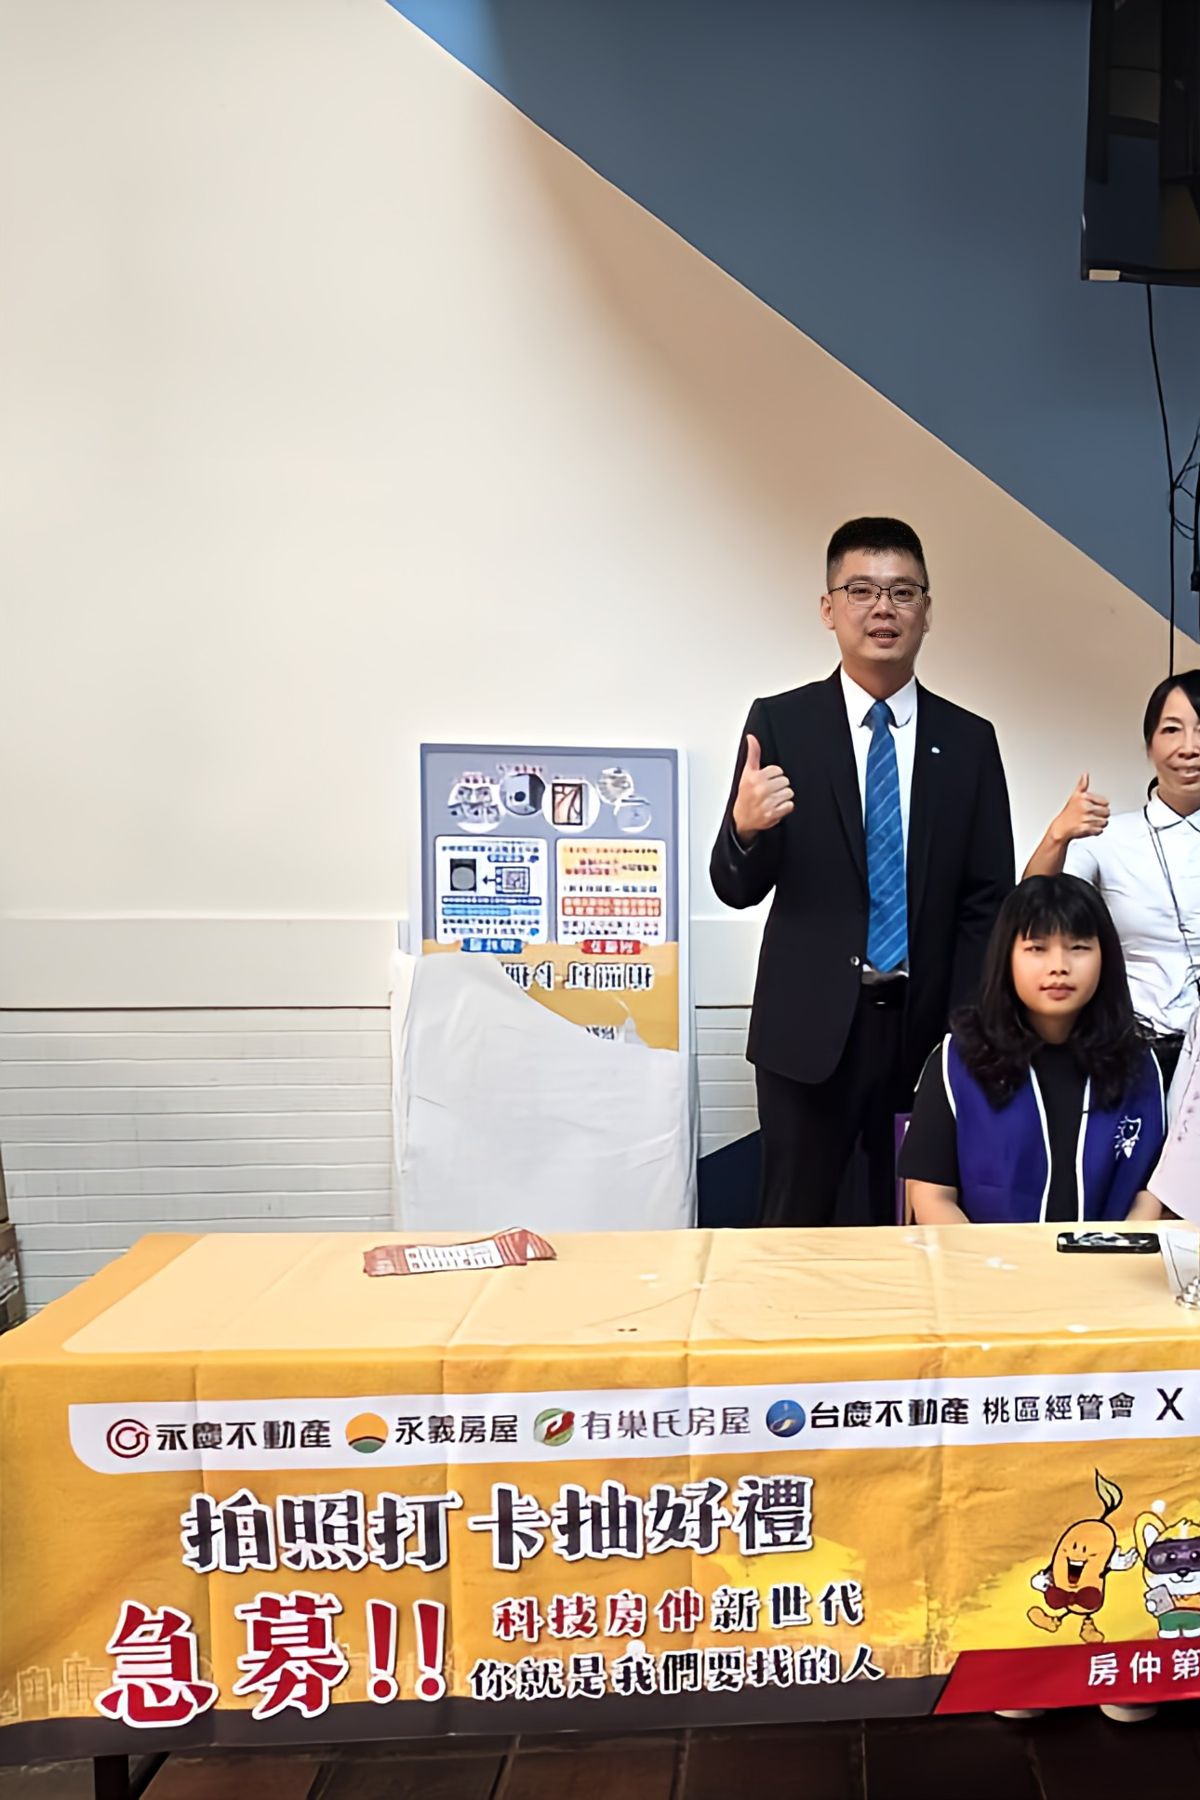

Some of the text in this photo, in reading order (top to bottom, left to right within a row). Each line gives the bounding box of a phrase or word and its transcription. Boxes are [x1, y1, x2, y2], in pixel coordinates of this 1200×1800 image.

[157, 1419, 332, 1452] 永慶不動產
[396, 1415, 518, 1446] 永義房屋
[582, 1407, 751, 1440] 有巢氏房屋
[810, 1398, 970, 1430] 台慶不動產
[983, 1392, 1136, 1424] 桃區經管會
[181, 1475, 815, 1573] 拍照打卡抽好禮
[493, 1582, 865, 1641] 科技房仲新世代
[470, 1644, 883, 1700] 你就是我們要找的人
